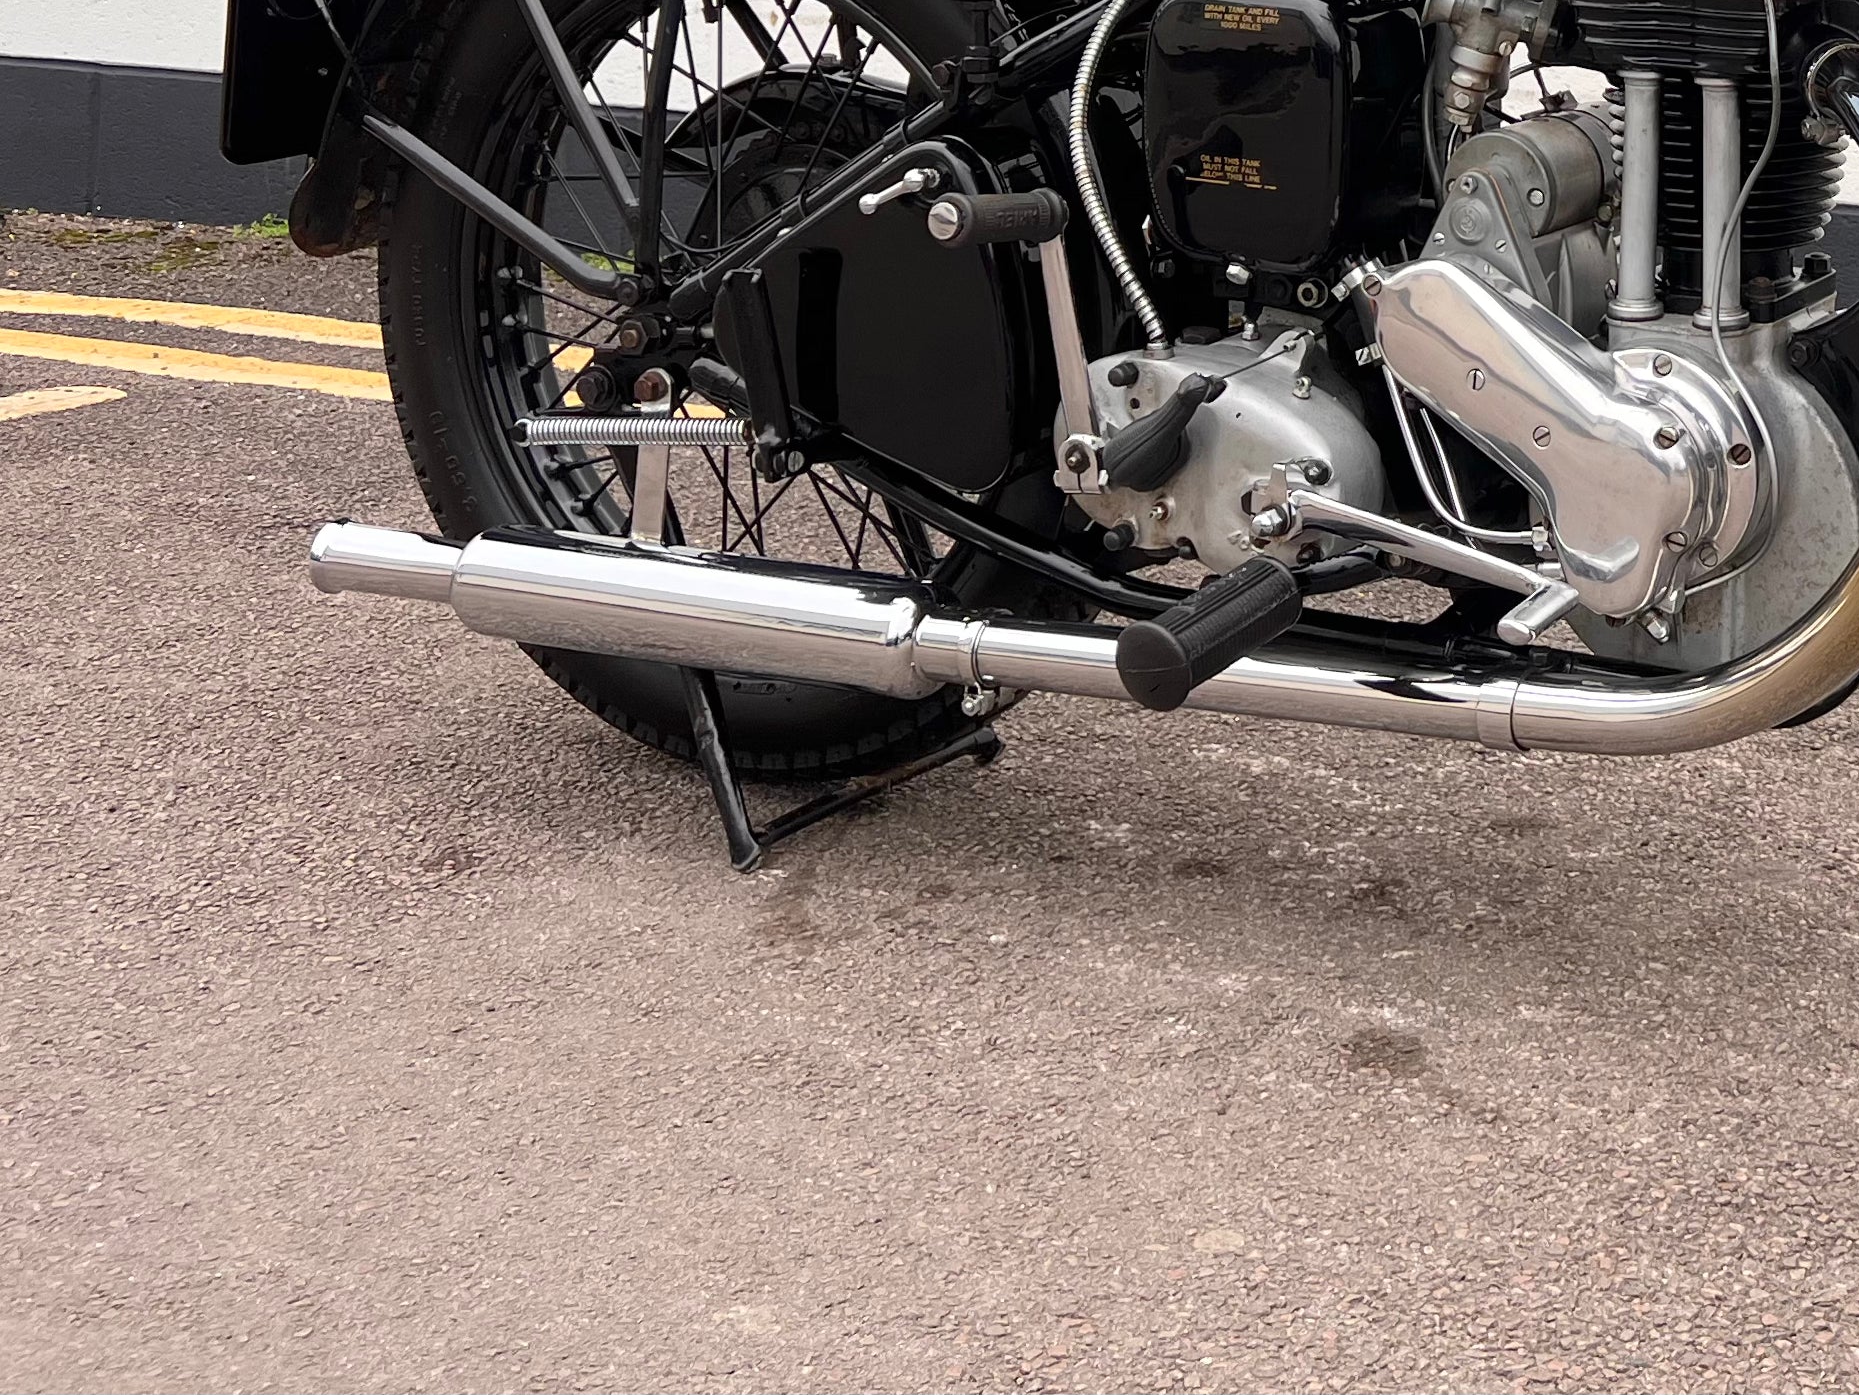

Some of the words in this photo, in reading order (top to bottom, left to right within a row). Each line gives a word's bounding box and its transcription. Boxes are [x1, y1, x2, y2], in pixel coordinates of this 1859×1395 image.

[1204, 4, 1225, 12] DRAIN
[1228, 6, 1247, 14] TANK
[1248, 7, 1263, 15] AND
[1242, 15, 1253, 23] OIL
[1256, 17, 1280, 25] EVERY
[1239, 23, 1262, 31] MILES
[1200, 154, 1212, 162] OIL
[1224, 157, 1239, 165] THIS
[1242, 158, 1260, 166] TANK
[1203, 163, 1222, 171] MUST
[1241, 166, 1258, 174] FALL
[1226, 172, 1243, 181] THIS
[1244, 175, 1260, 183] LINE
